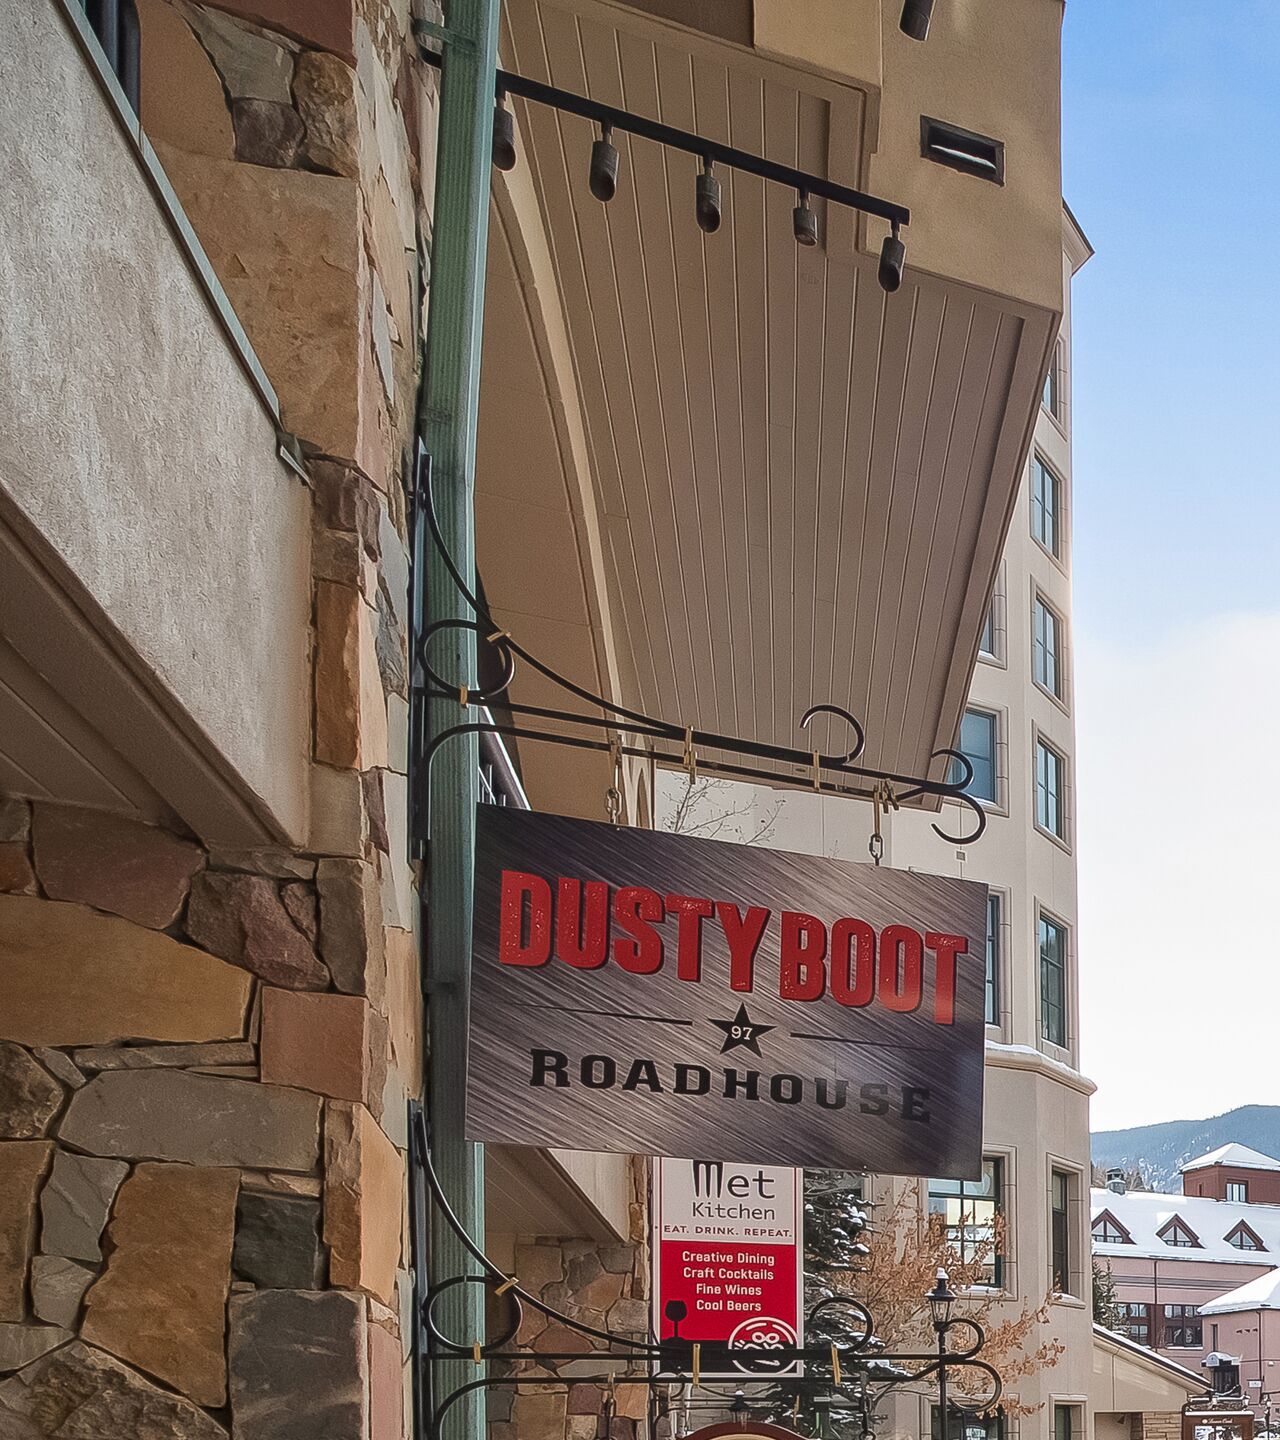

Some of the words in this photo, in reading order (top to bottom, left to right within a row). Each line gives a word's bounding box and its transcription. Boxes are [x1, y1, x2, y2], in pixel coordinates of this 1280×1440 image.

[501, 870, 770, 994] DUSTY
[779, 911, 969, 1025] BOOT
[731, 1025, 753, 1040] 97
[529, 1048, 931, 1124] ROADHOUSE
[692, 1201, 775, 1220] Kitchen
[663, 1224, 690, 1234] EAT.
[695, 1226, 739, 1236] DRINK.
[744, 1228, 793, 1238] REPEAT.
[682, 1250, 734, 1263] Creative
[737, 1252, 775, 1267] Dining
[683, 1266, 715, 1279] Craft
[718, 1267, 775, 1281] Cocktails
[696, 1283, 722, 1295] Fine
[724, 1284, 762, 1296] Wines
[696, 1299, 723, 1311] Cool
[726, 1300, 762, 1312] Beers
